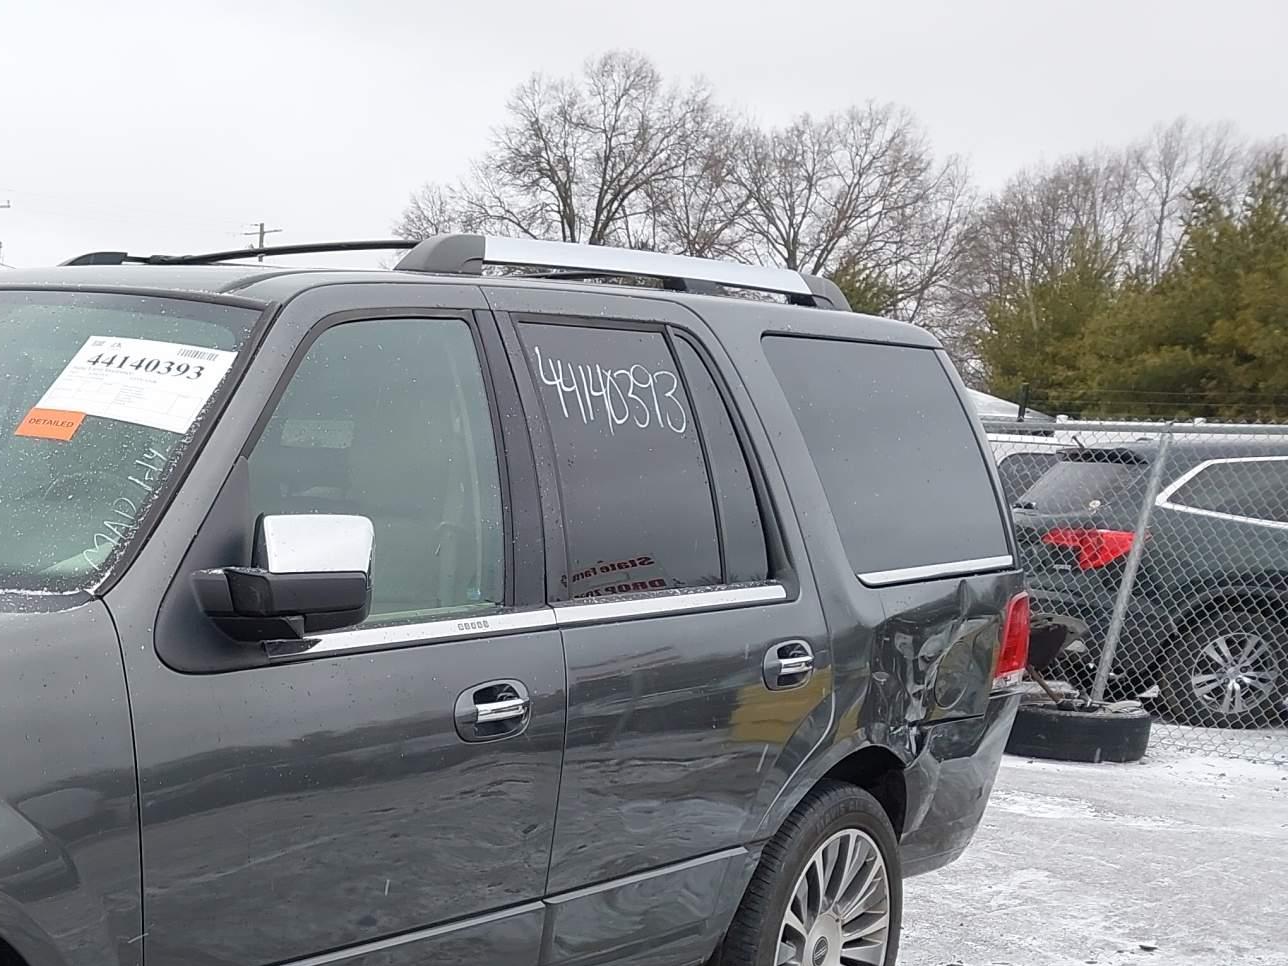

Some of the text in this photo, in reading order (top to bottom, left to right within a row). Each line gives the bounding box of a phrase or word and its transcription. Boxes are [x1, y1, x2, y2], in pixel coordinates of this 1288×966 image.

[87, 352, 206, 381] 44140393
[534, 346, 687, 436] 44140393
[28, 417, 75, 429] DETAILED
